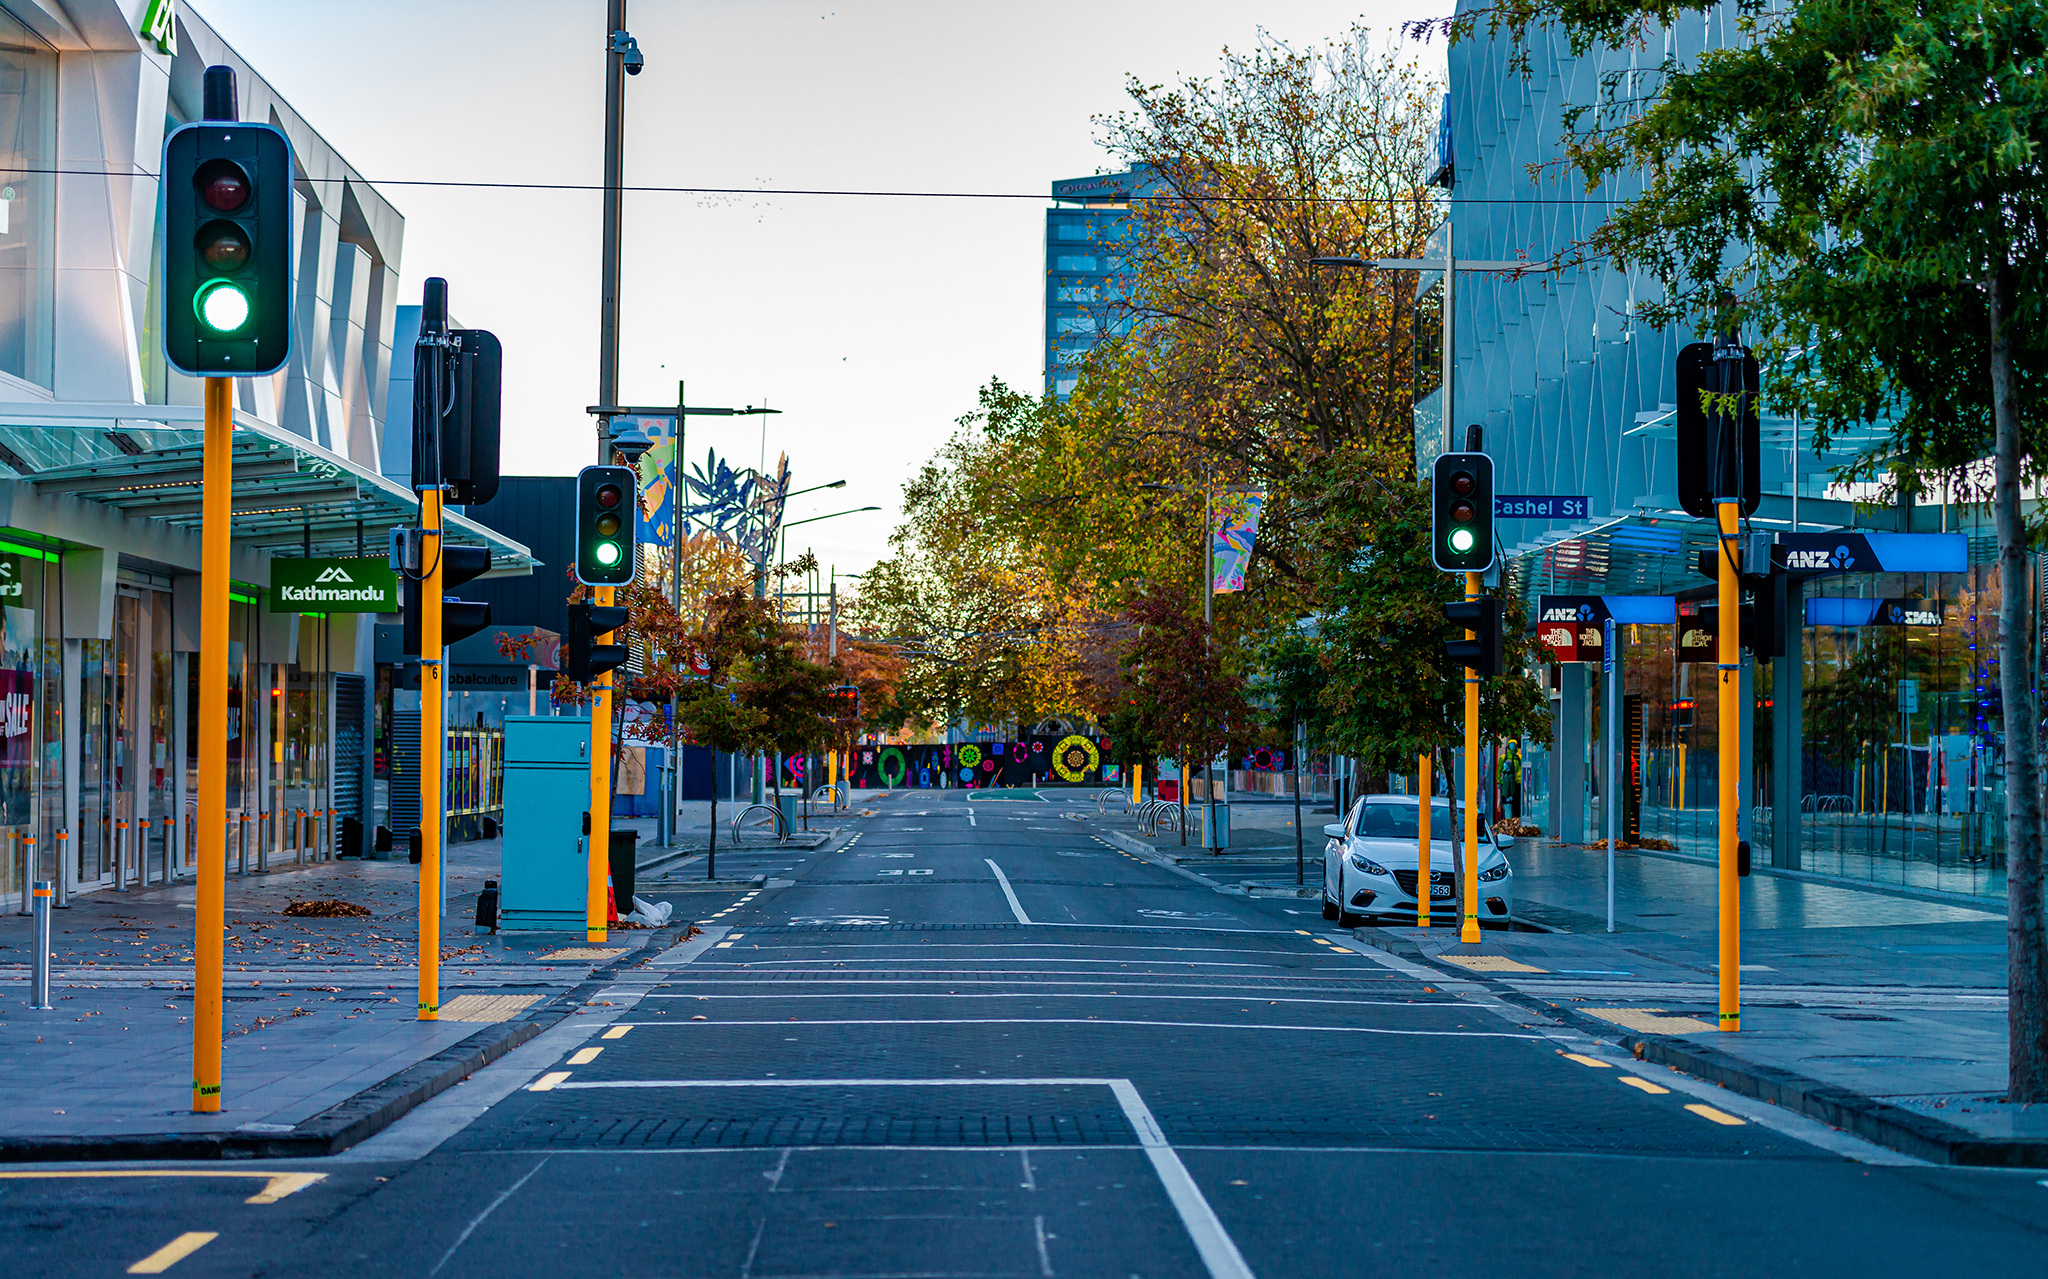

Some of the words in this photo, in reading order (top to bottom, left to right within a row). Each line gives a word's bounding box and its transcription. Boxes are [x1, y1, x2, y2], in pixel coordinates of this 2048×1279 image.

[1495, 499, 1553, 515] Cashel
[1562, 499, 1583, 515] St
[1787, 551, 1830, 568] ANZ
[282, 585, 385, 601] Kathmandu
[1542, 608, 1577, 621] ANZ
[432, 667, 438, 679] 6
[449, 673, 518, 685] obalculture
[1723, 671, 1729, 684] 4
[5, 692, 29, 738] SALE
